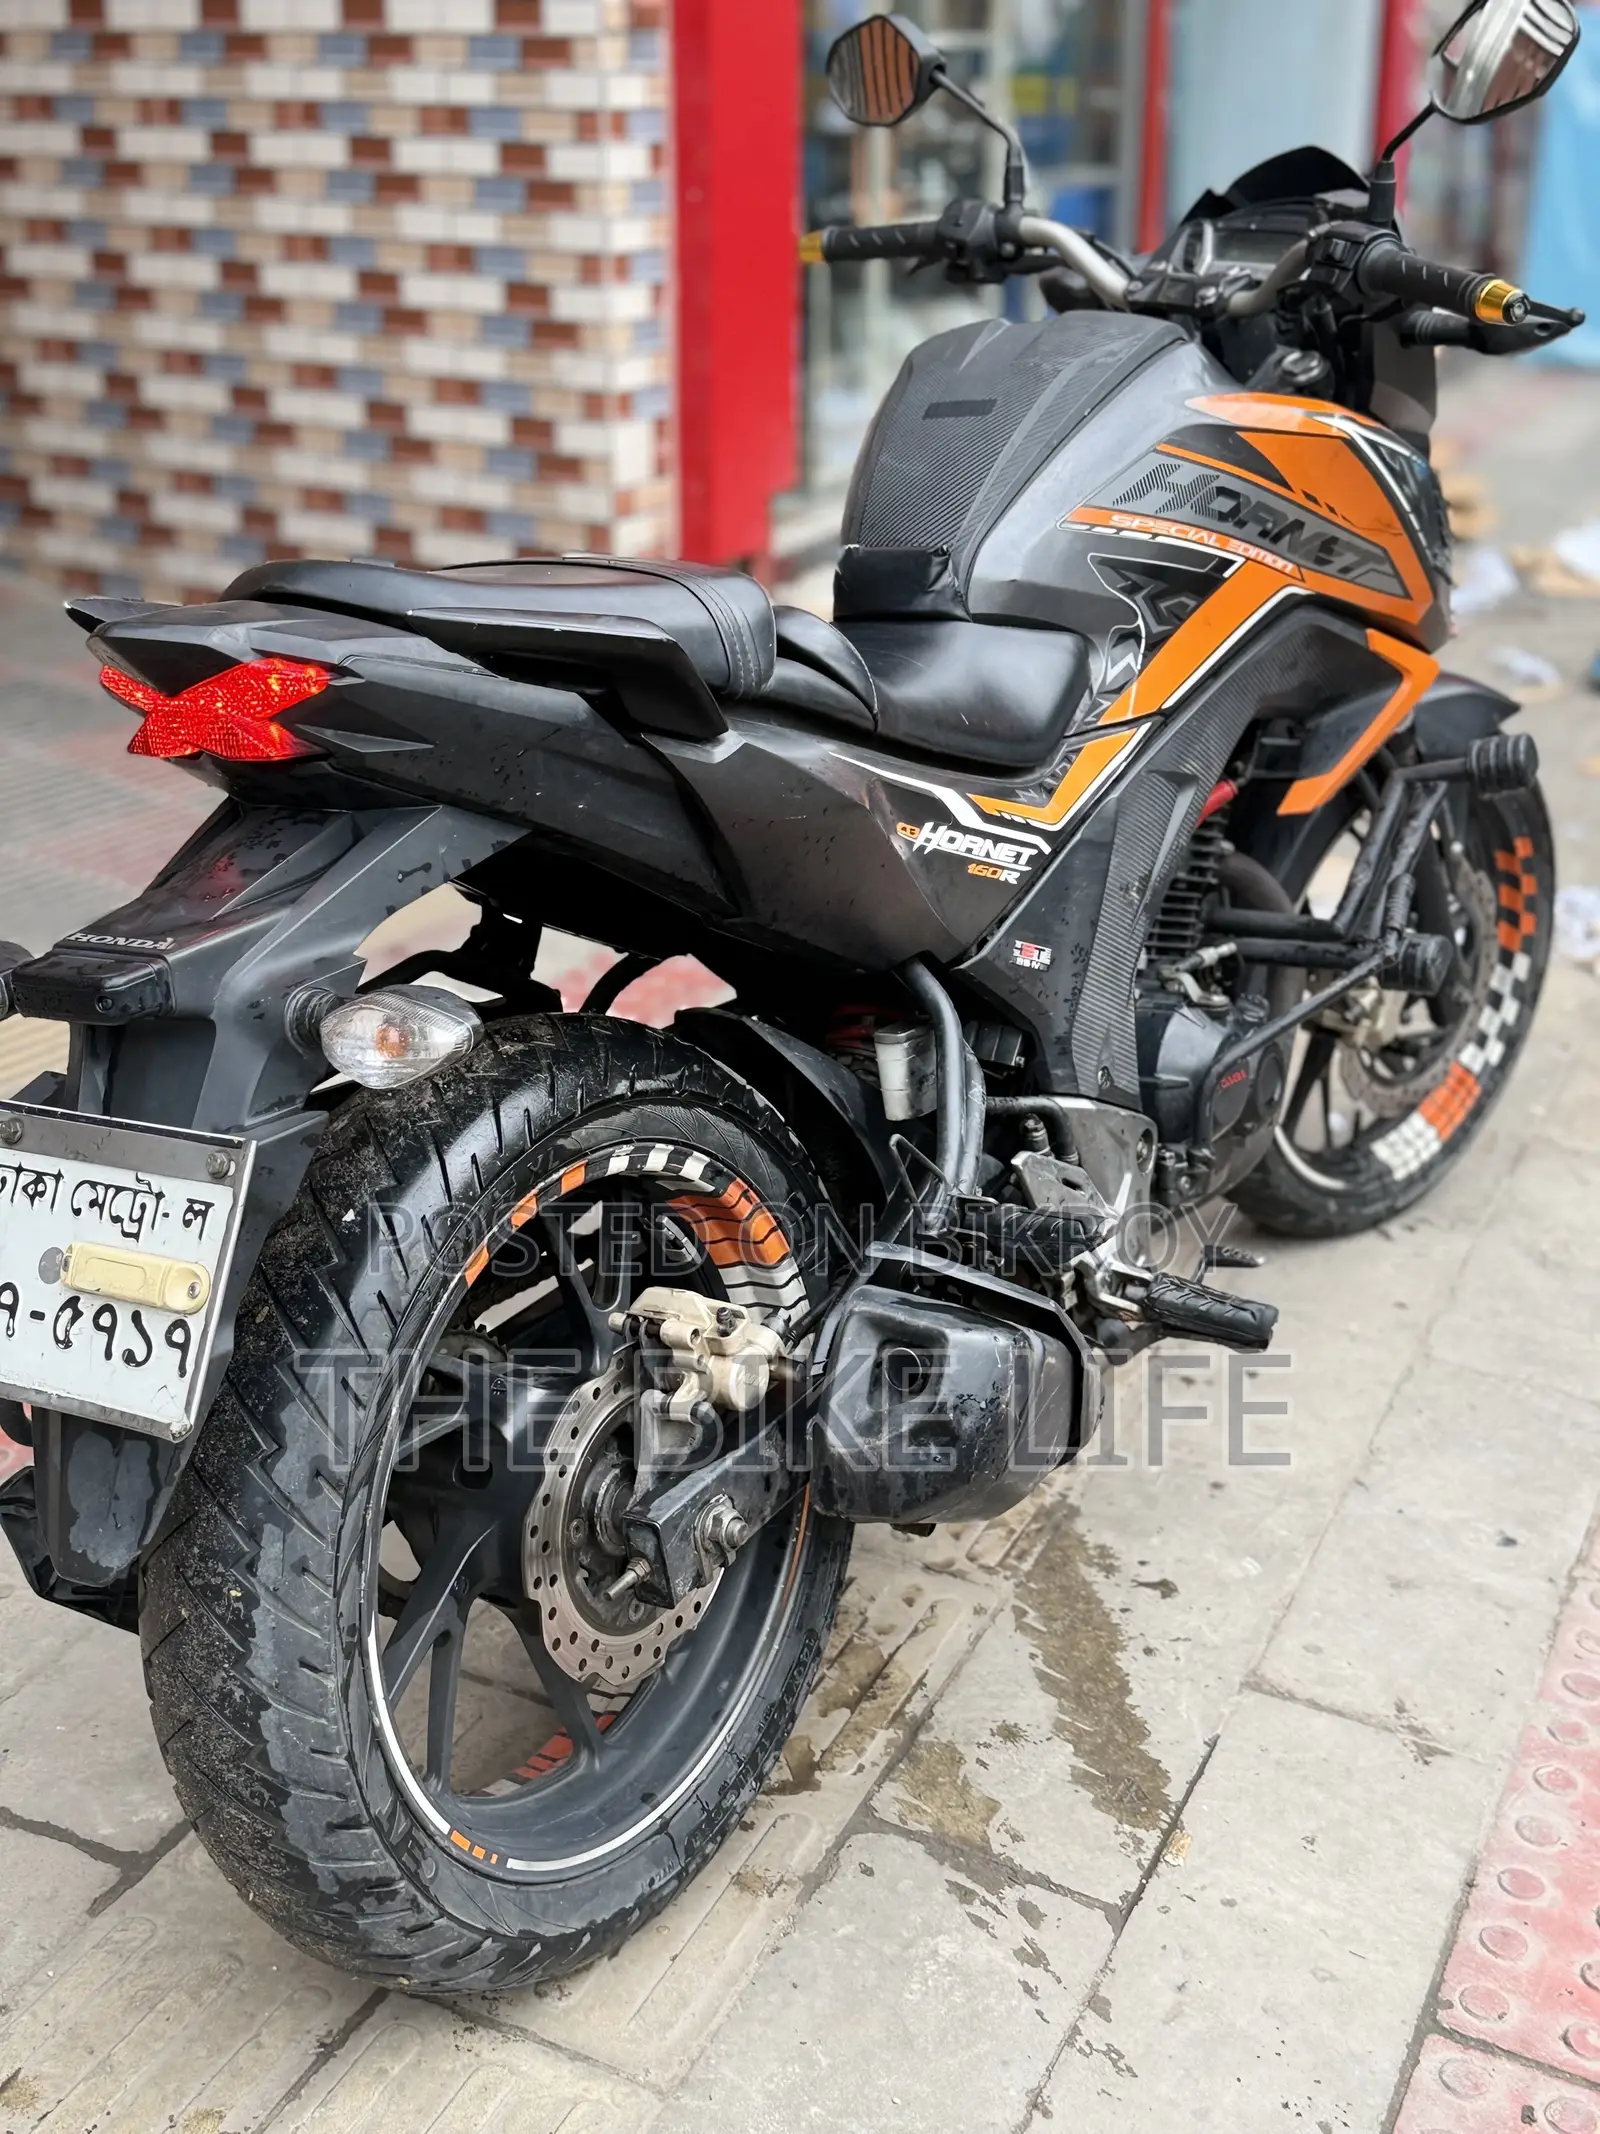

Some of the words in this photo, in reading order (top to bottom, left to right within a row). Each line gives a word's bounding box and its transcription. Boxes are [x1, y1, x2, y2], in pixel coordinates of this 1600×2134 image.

[1109, 514, 1218, 546] SPECIAL
[1112, 463, 1379, 573] HORNET
[912, 821, 1039, 868] HORNET
[967, 863, 1021, 885] 160R
[66, 932, 175, 950] HONDA
